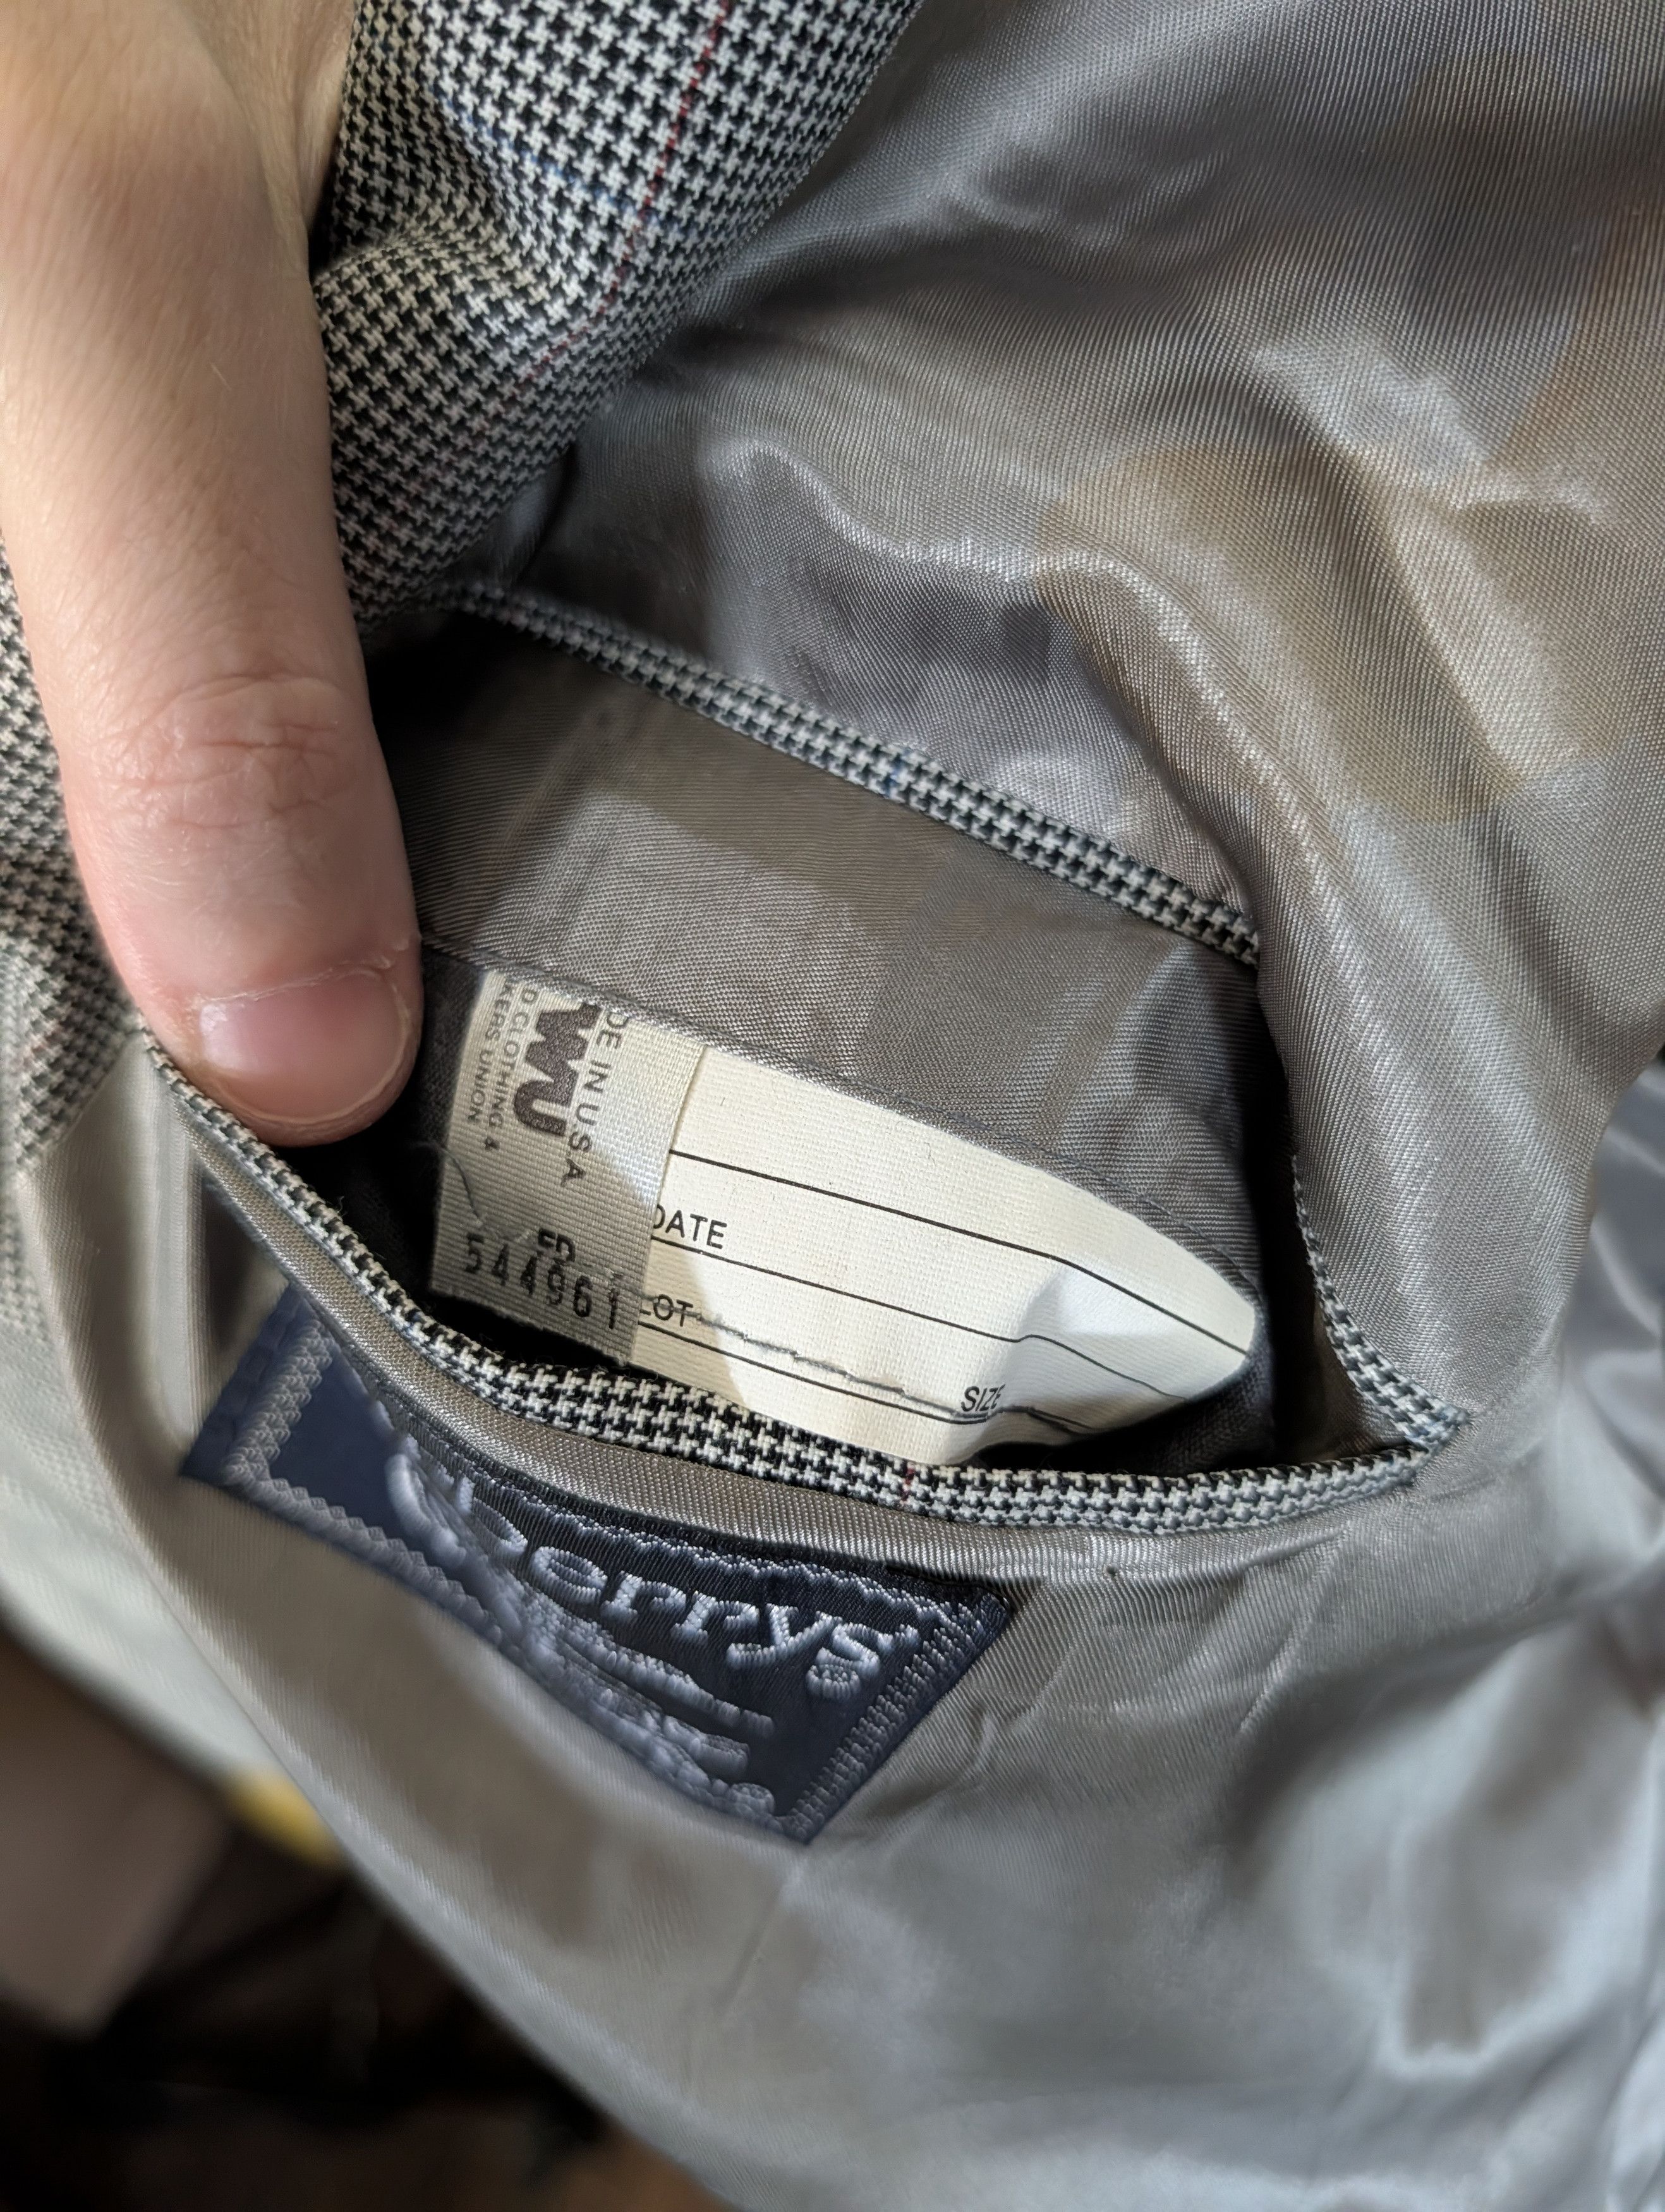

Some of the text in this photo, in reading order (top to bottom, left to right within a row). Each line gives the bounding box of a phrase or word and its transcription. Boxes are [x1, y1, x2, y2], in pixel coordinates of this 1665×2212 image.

[466, 1050, 494, 1122] UNION
[488, 1012, 530, 1128] CLOTHING
[583, 1059, 612, 1094] IN
[960, 1383, 1006, 1412] SIZE
